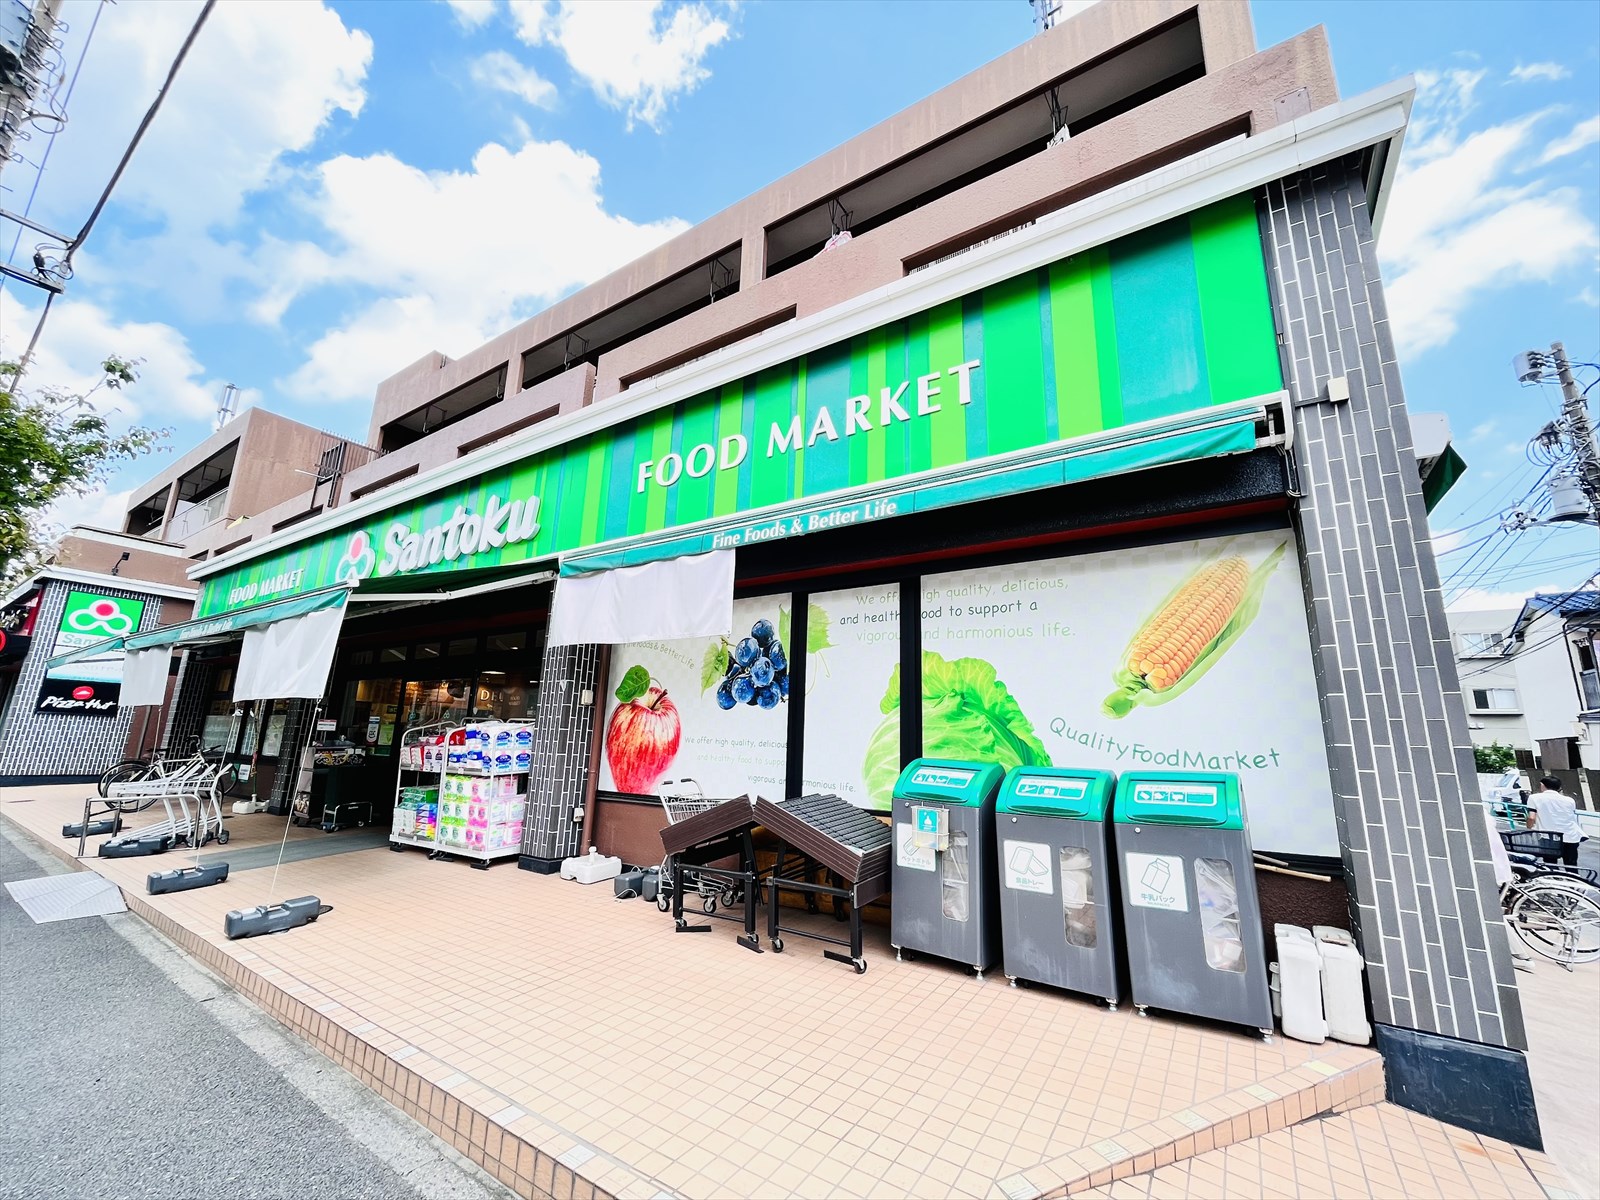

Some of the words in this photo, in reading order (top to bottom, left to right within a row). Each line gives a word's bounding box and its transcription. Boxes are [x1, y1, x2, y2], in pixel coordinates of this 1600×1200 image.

[637, 434, 749, 494] FOOD
[766, 359, 981, 459] MARKET
[378, 494, 541, 577] Santoku
[712, 533, 741, 549] Fine
[744, 521, 786, 544] Foods
[790, 517, 804, 536] &
[808, 510, 860, 532] Better
[864, 499, 898, 520] Life
[228, 583, 258, 605] FOOD
[258, 569, 304, 597] MARKET
[856, 594, 875, 606] We
[879, 591, 901, 604] off
[921, 588, 941, 603] igh
[946, 583, 997, 600] quality,
[1001, 576, 1069, 594] delicious,
[839, 612, 859, 625] and
[863, 610, 901, 624] health
[920, 606, 943, 620] ood
[949, 605, 963, 617] to
[968, 599, 1022, 617] support
[1029, 601, 1038, 612] a
[856, 630, 901, 645] vigorou
[921, 626, 941, 640] nd
[946, 624, 1034, 640] harmonious
[1041, 621, 1077, 638] life.
[41, 696, 84, 709] Pizza
[84, 698, 117, 710] Hut
[697, 736, 713, 745] offer
[715, 737, 729, 748] high
[731, 738, 756, 748] quality,
[697, 753, 709, 761] and
[710, 754, 735, 765] healthy
[737, 755, 752, 764] food
[755, 756, 763, 764] to
[765, 758, 786, 768] suppo
[747, 774, 776, 785] vigorous
[839, 782, 857, 793] life.
[1140, 892, 1176, 904] 牛乳パック
